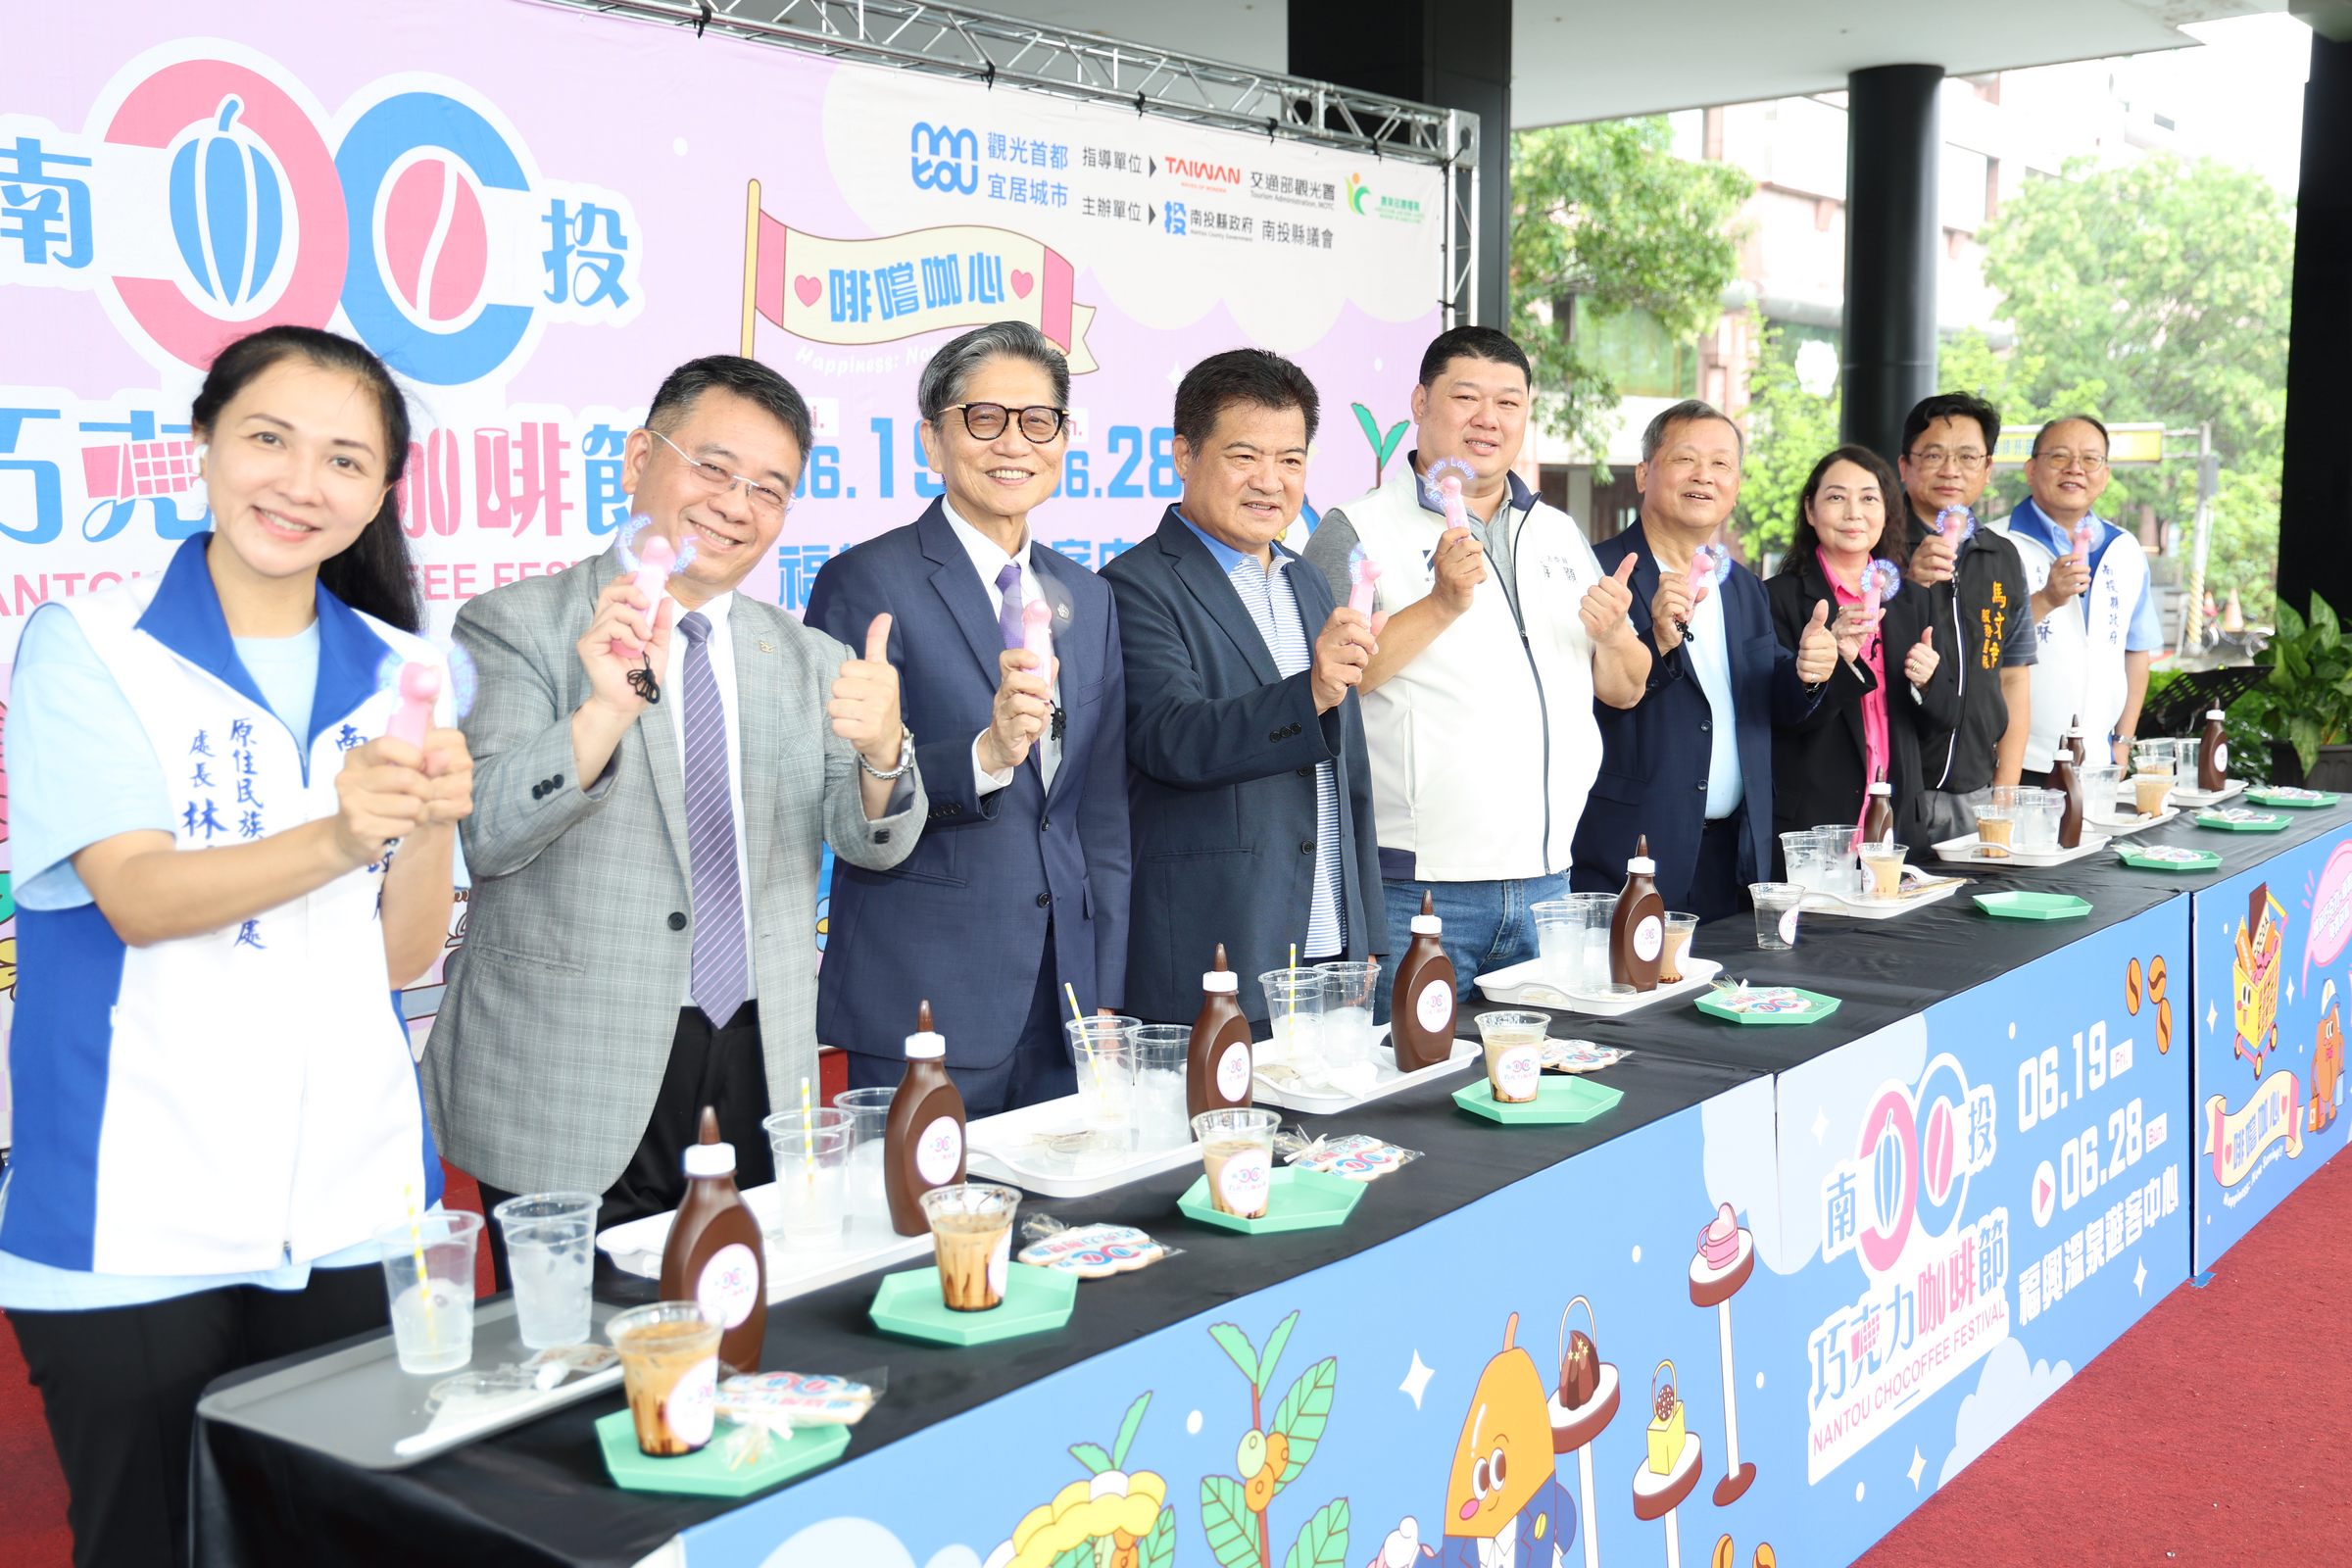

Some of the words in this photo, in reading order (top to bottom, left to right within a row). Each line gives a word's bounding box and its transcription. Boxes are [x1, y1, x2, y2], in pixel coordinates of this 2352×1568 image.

[987, 132, 1068, 171] 觀光首都
[1082, 146, 1143, 175] 指導單位
[1164, 156, 1241, 185] TAIWAN
[1250, 172, 1335, 202] 交通部觀光署
[987, 173, 1068, 208] 宜居城市
[1082, 195, 1142, 221] 主辦單位
[1190, 209, 1253, 234] 南投縣政府
[1261, 220, 1334, 250] 南投縣議會
[828, 252, 1005, 324] 啡嚐咖心
[2019, 1019, 2107, 1134] 06.19
[2114, 1049, 2129, 1071] Fri.
[2061, 1098, 2143, 1212] 06.28
[2018, 1162, 2180, 1327] 福興溫泉遊客中心
[1813, 1218, 2004, 1411] 巧克力咖啡節
[1813, 1391, 1871, 1457] NANTOU
[1874, 1336, 1950, 1411] CHOCOFFEE
[1953, 1299, 2005, 1354] FESTIVAL
